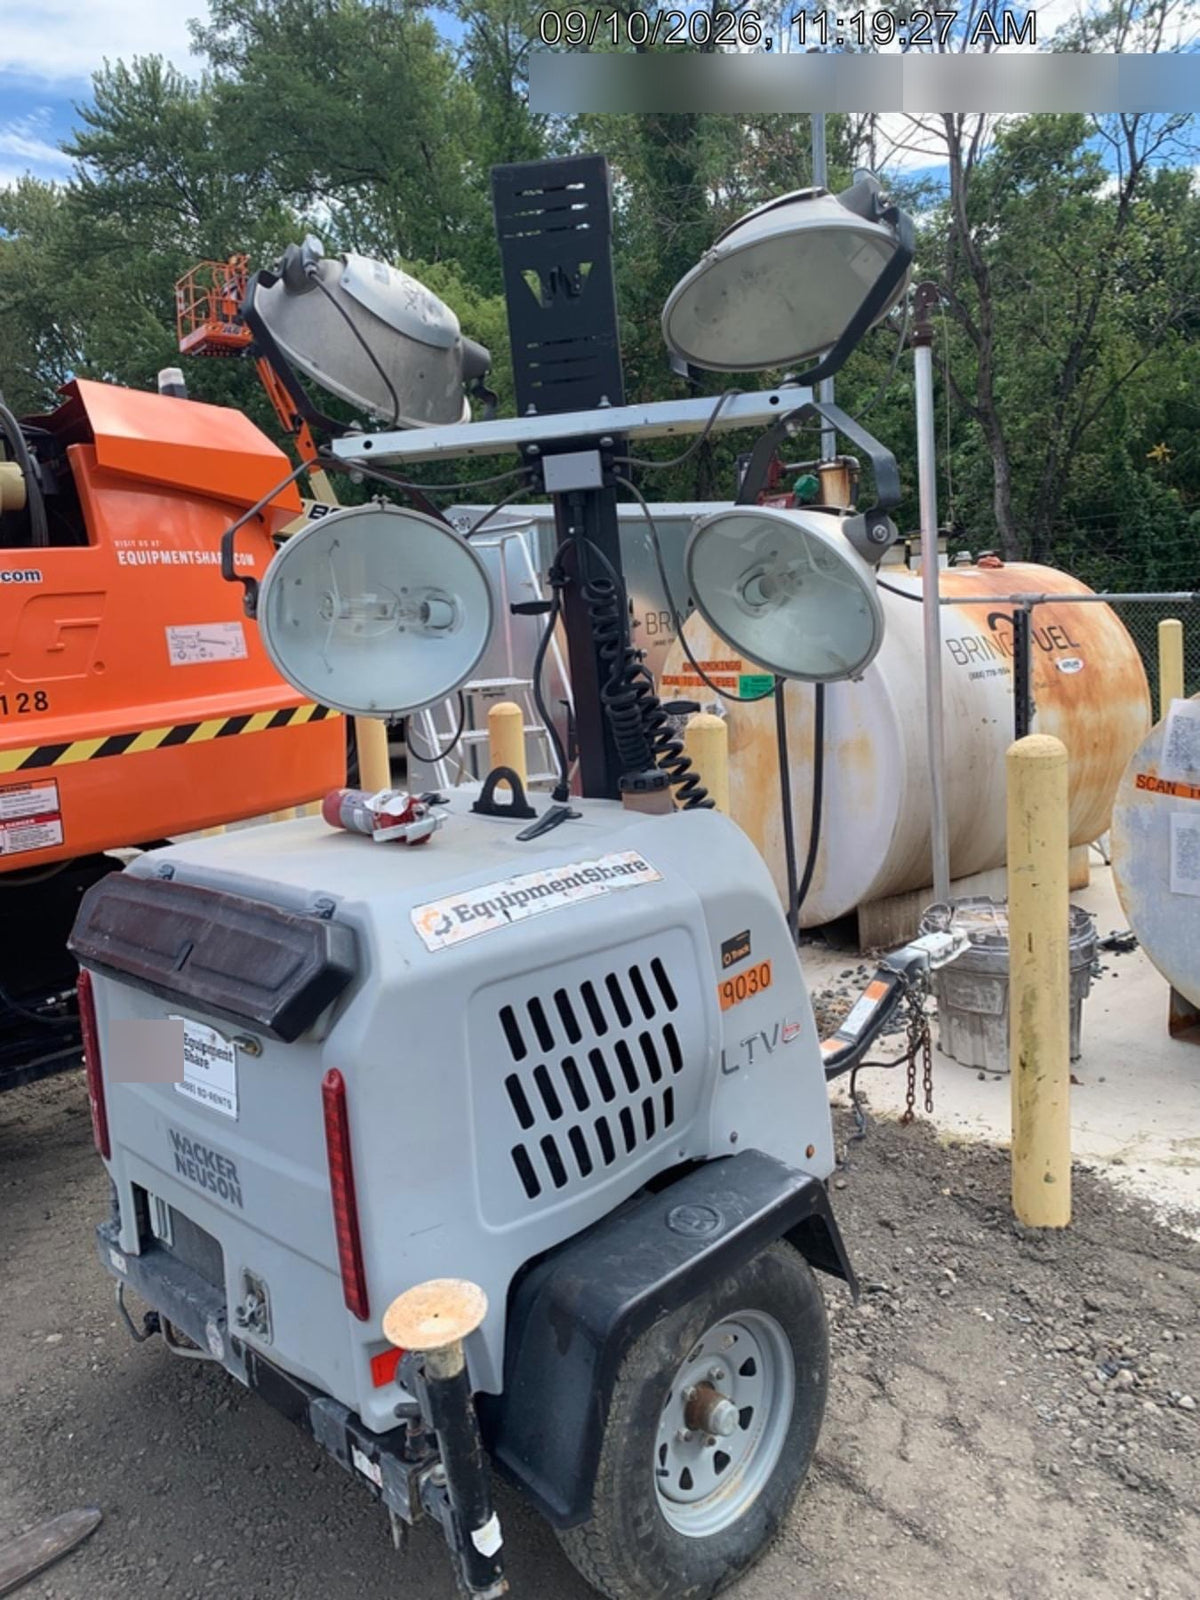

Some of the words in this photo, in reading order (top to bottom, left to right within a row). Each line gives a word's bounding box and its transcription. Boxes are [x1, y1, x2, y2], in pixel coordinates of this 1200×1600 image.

[1030, 625, 1081, 652] UEL
[1135, 773, 1176, 796] SCAN
[451, 859, 650, 923] EquipmentShare
[722, 962, 771, 1005] 9030
[169, 1128, 240, 1185] WACKER
[173, 1151, 244, 1209] NEUSON
